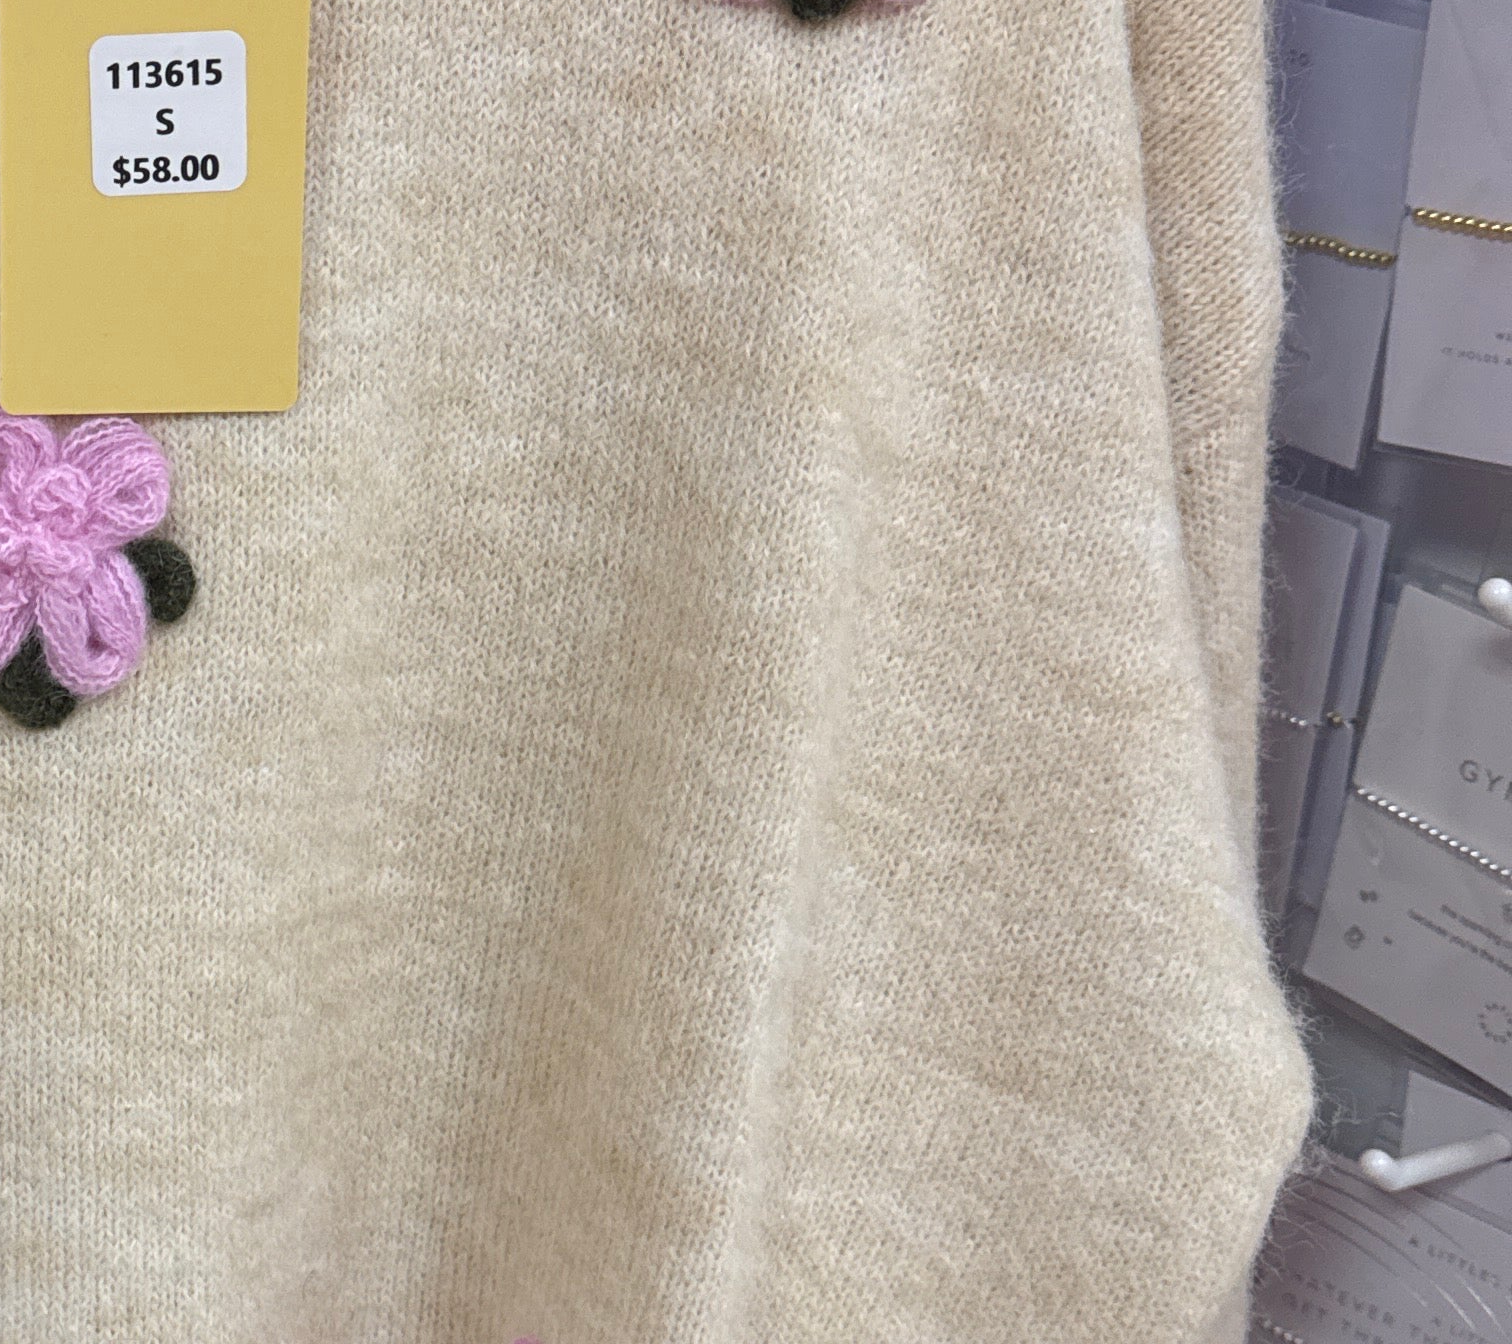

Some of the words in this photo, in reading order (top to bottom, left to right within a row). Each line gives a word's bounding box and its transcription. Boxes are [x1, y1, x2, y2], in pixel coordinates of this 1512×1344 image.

[106, 58, 223, 89] 113615
[155, 108, 175, 135] S
[112, 154, 220, 188] $58.00
